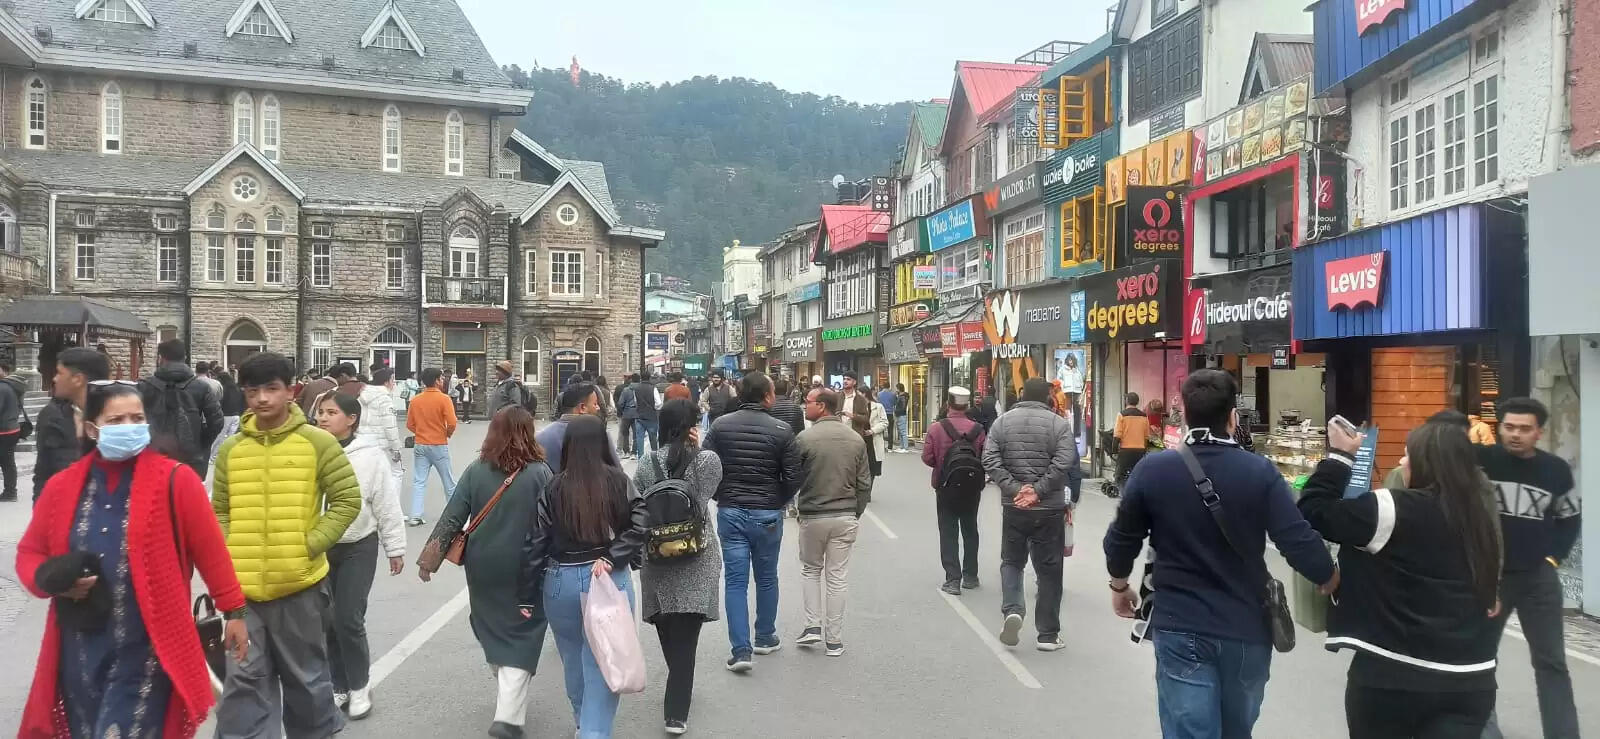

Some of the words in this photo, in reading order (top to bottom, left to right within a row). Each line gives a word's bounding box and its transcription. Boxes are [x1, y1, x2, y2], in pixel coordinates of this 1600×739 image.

[1043, 168, 1062, 186] wake
[1075, 153, 1096, 174] bake
[1000, 174, 1036, 201] WILDCRAFT
[1134, 228, 1180, 241] xero
[1134, 240, 1179, 252] degrees
[1116, 272, 1158, 300] xero
[1087, 300, 1160, 338] degrees
[1206, 299, 1251, 325] Hideout
[1254, 292, 1288, 320] Café
[786, 335, 813, 349] OCTAVE
